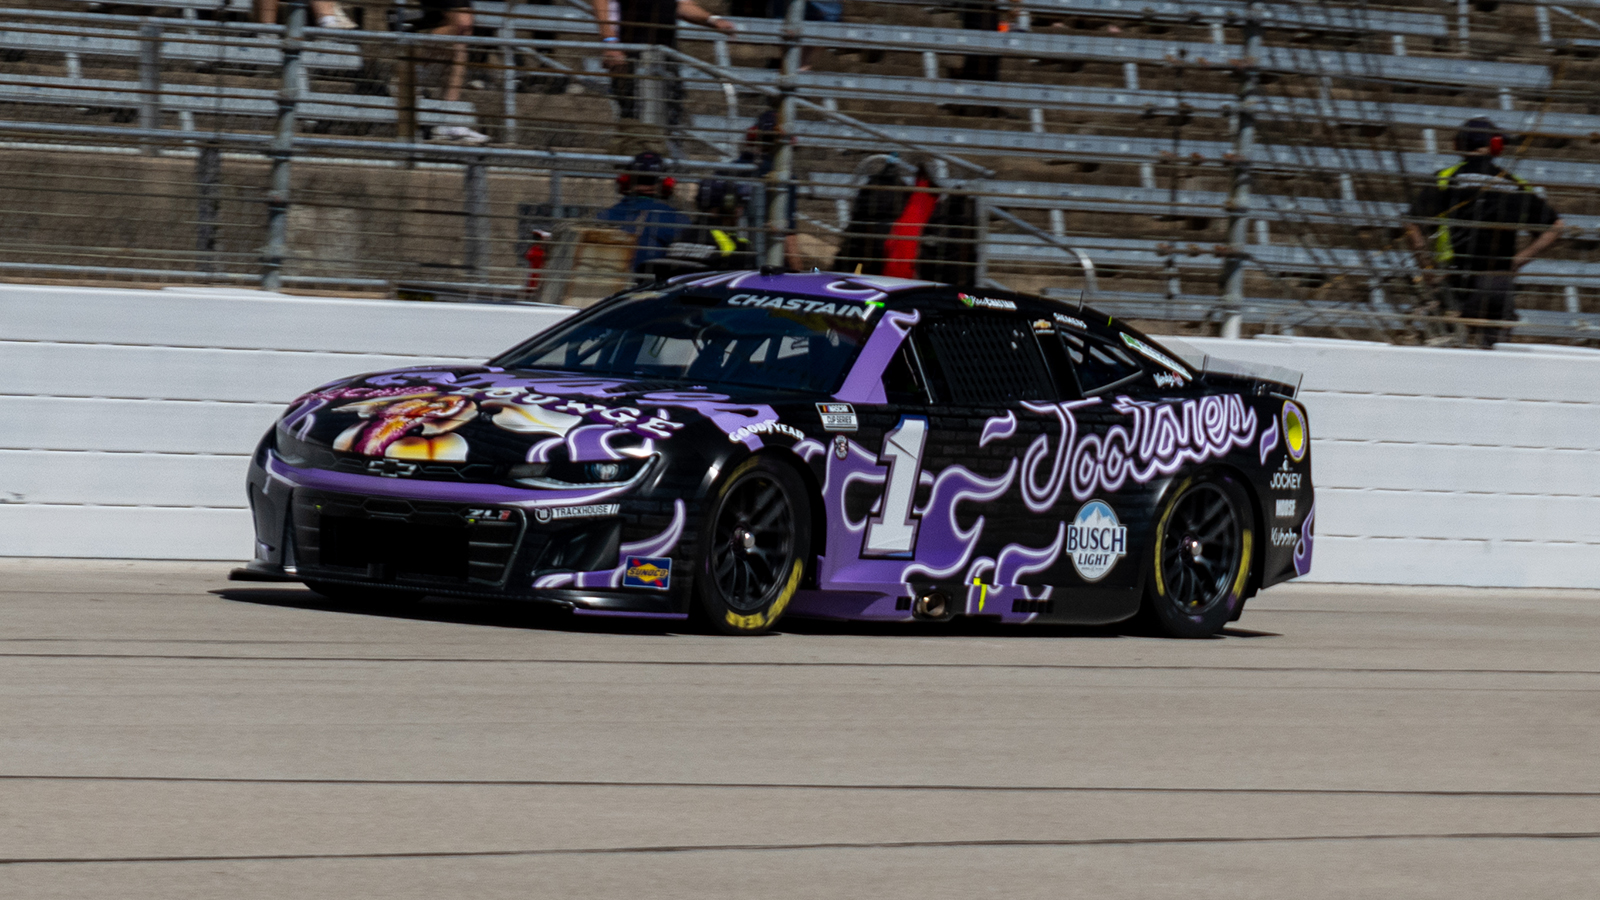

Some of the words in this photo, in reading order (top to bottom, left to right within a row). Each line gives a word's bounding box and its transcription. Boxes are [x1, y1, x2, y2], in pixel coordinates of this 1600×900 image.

[727, 293, 868, 318] CHASTAIN
[837, 415, 852, 424] SERIES
[728, 419, 805, 442] GOODYEAR
[865, 415, 928, 557] 1
[1270, 472, 1302, 489] JOCKEY
[554, 505, 610, 518] TRACKHOUSE
[1067, 526, 1125, 553] BUSCH
[1077, 553, 1110, 566] LIGHT
[626, 566, 669, 578] SUNOCO
